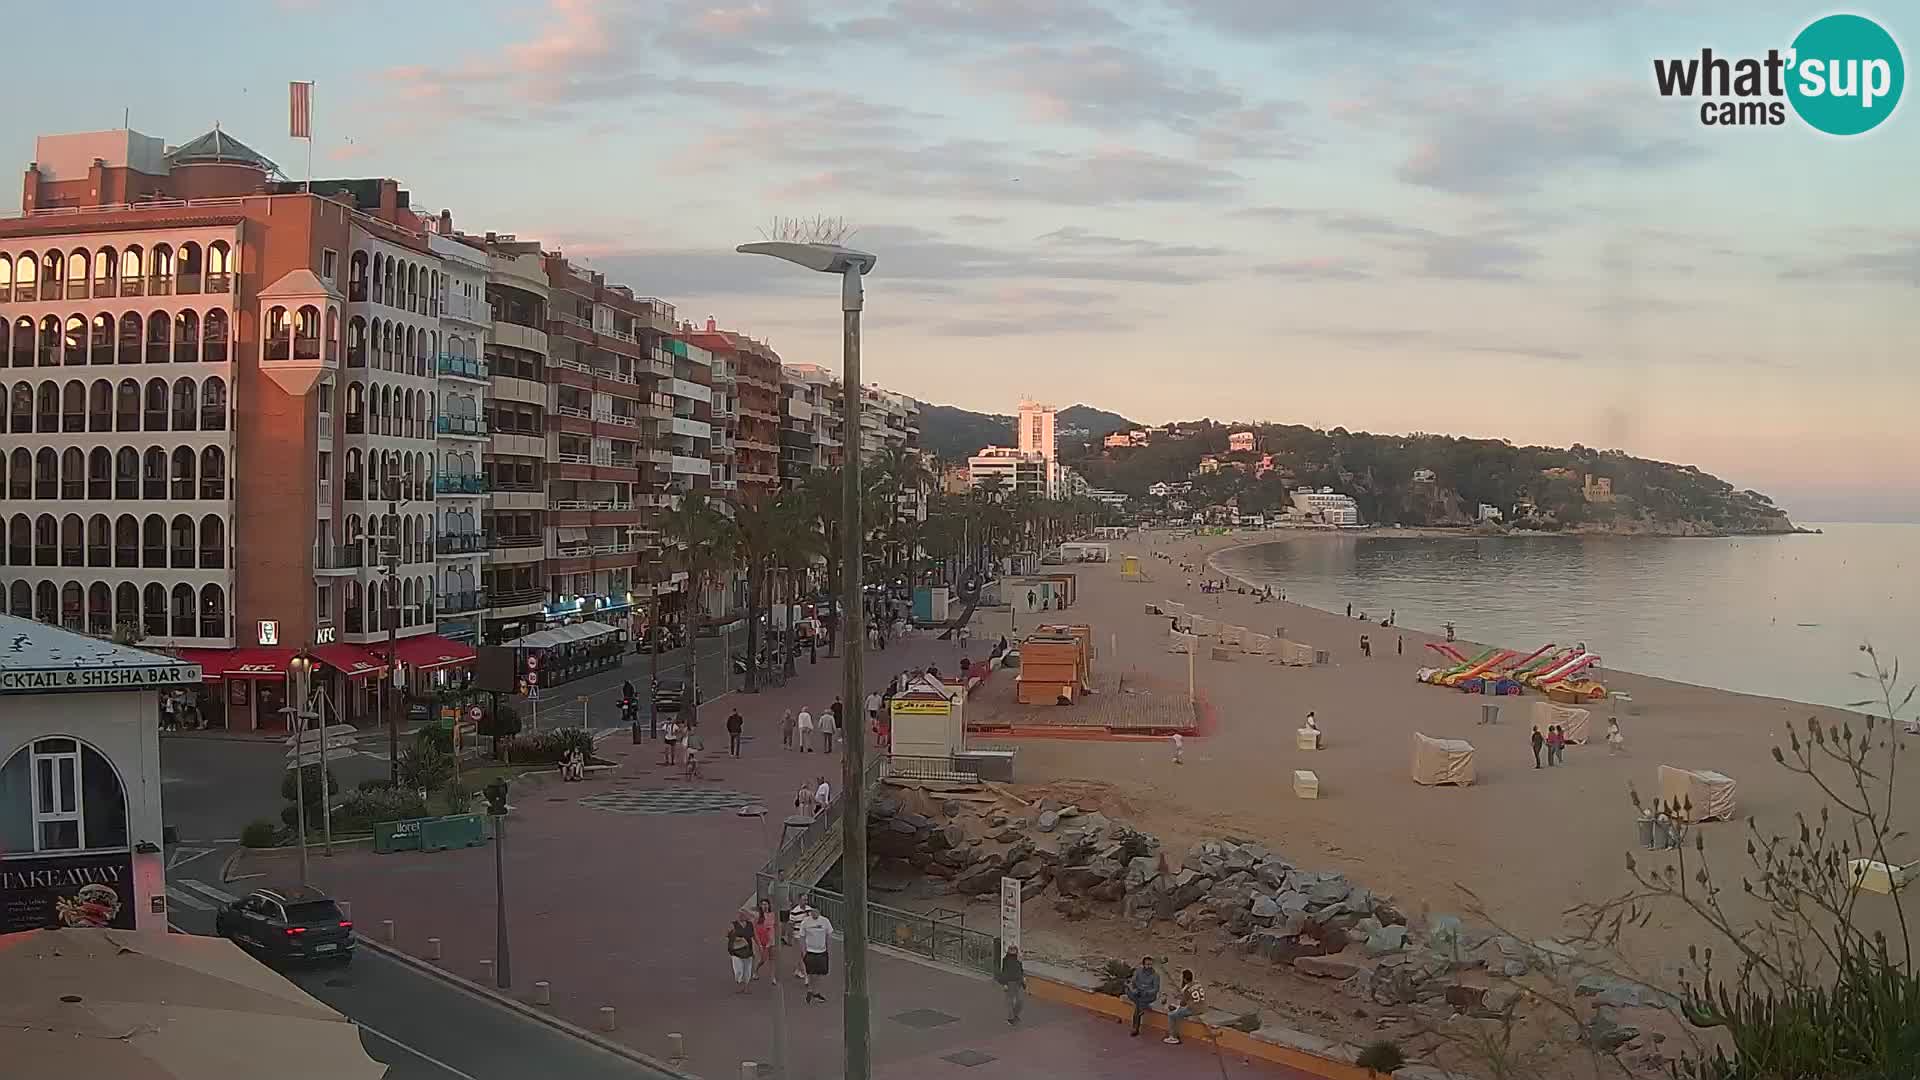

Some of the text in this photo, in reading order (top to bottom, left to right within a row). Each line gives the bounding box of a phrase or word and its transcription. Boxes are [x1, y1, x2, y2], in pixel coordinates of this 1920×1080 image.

[316, 627, 336, 644] KFC
[0, 668, 181, 688] CKTAIL & SHISHA BAR
[1, 865, 125, 889] TAKEAWAY
